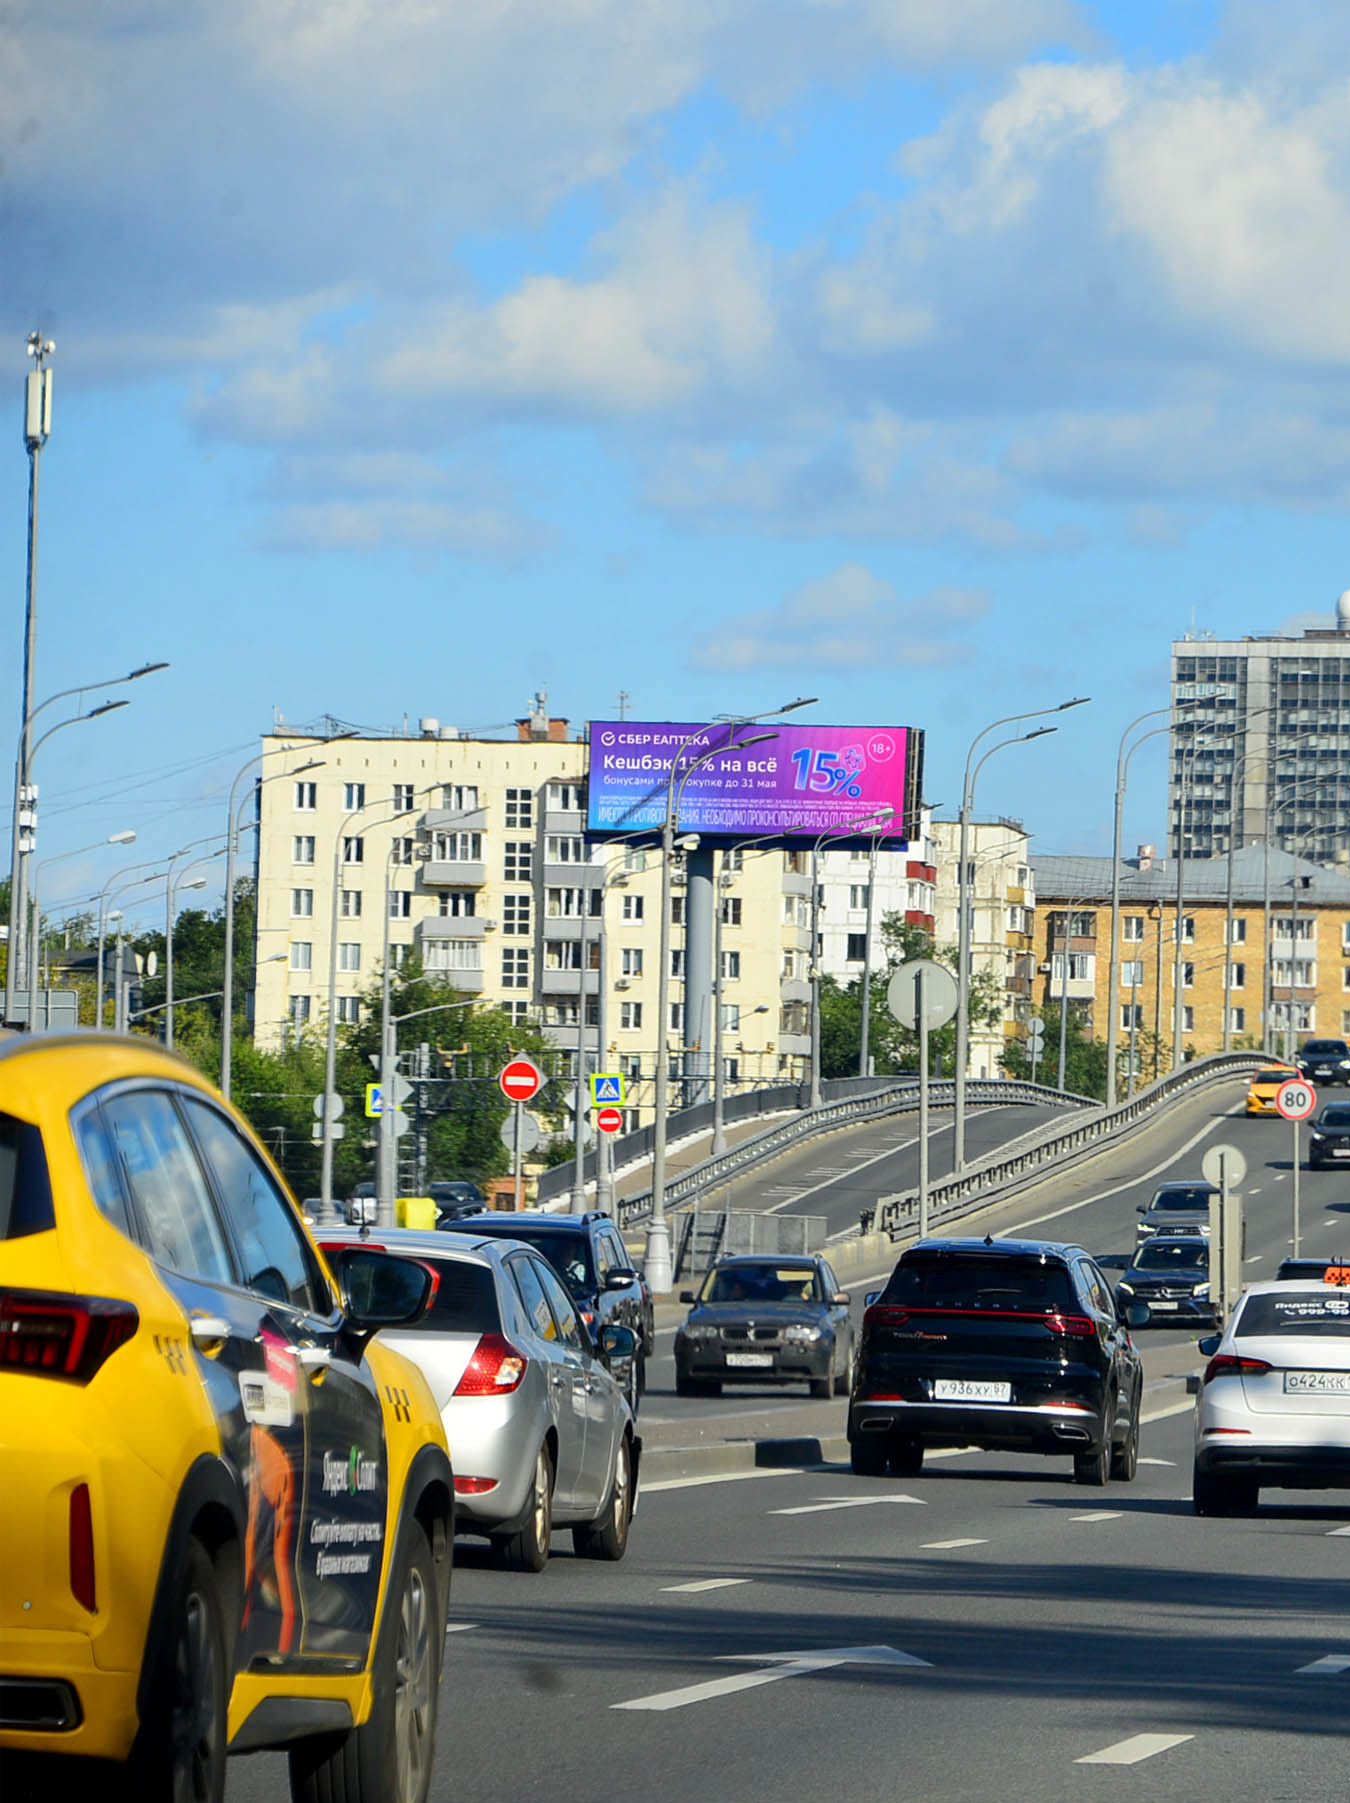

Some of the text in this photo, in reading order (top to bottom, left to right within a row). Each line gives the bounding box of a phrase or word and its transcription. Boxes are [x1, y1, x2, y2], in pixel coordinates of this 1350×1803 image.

[618, 733, 651, 745] СБЕР
[872, 743, 891, 754] 18+
[603, 754, 672, 771] Кешбэк
[720, 760, 741, 772] на
[746, 757, 777, 773] всё
[791, 747, 863, 799] 15%
[603, 775, 654, 786] бонусами
[679, 778, 722, 788] окупке
[725, 779, 738, 789] до
[741, 779, 753, 788] 31
[757, 780, 777, 788] мая
[1285, 1091, 1306, 1108] 80
